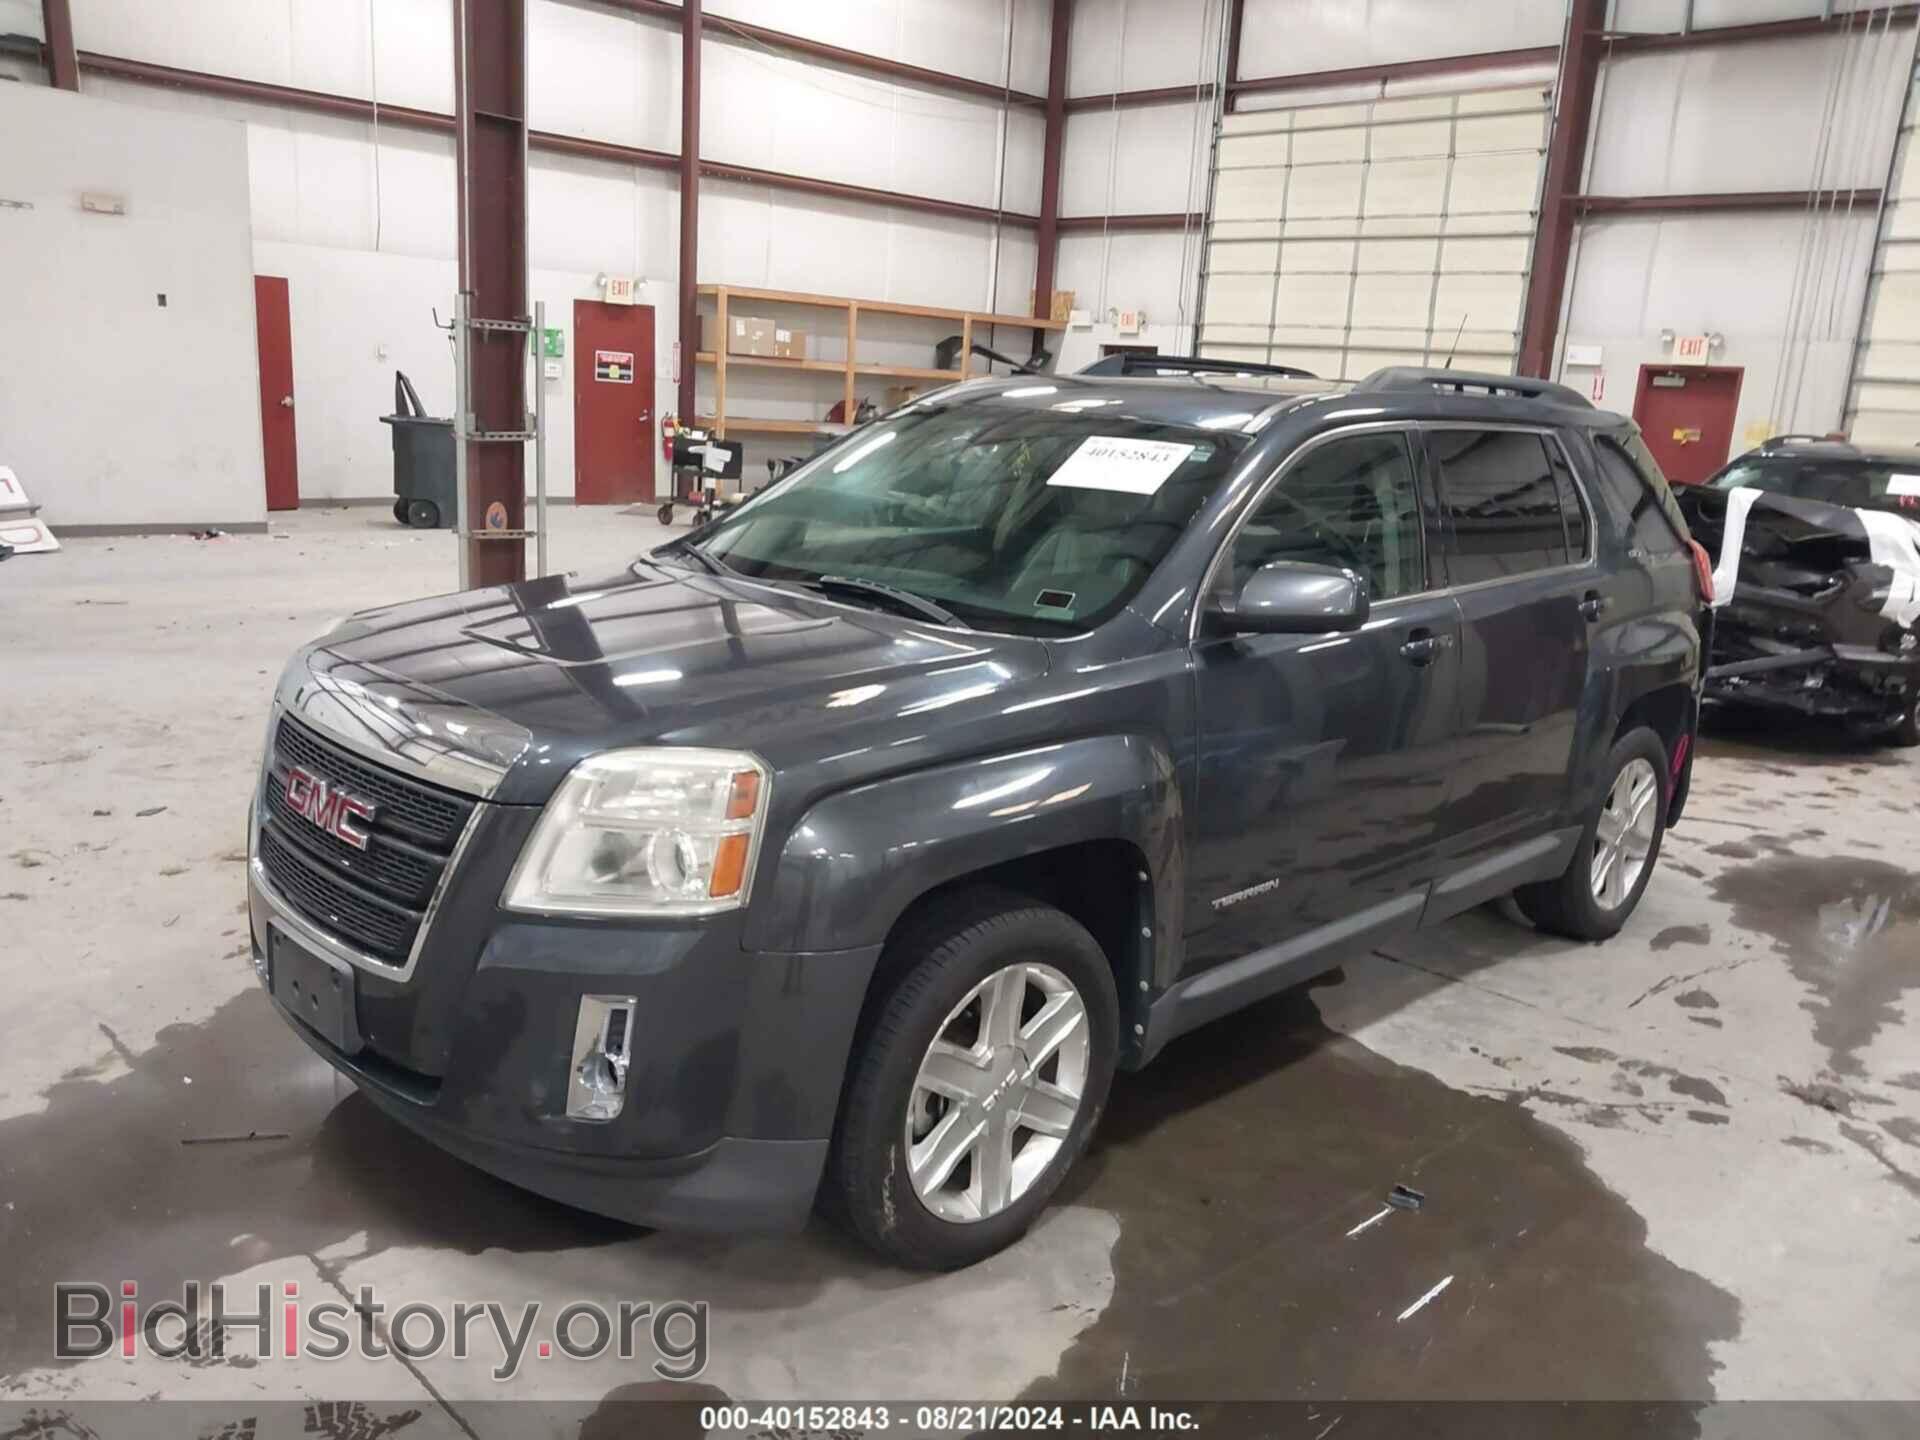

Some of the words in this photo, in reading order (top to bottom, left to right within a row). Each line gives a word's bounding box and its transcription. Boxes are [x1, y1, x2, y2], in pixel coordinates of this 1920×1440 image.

[611, 279, 630, 297] EXIT
[1680, 337, 1705, 357] EXIT
[284, 766, 375, 852] GMC
[1211, 877, 1280, 910] TERRAIN
